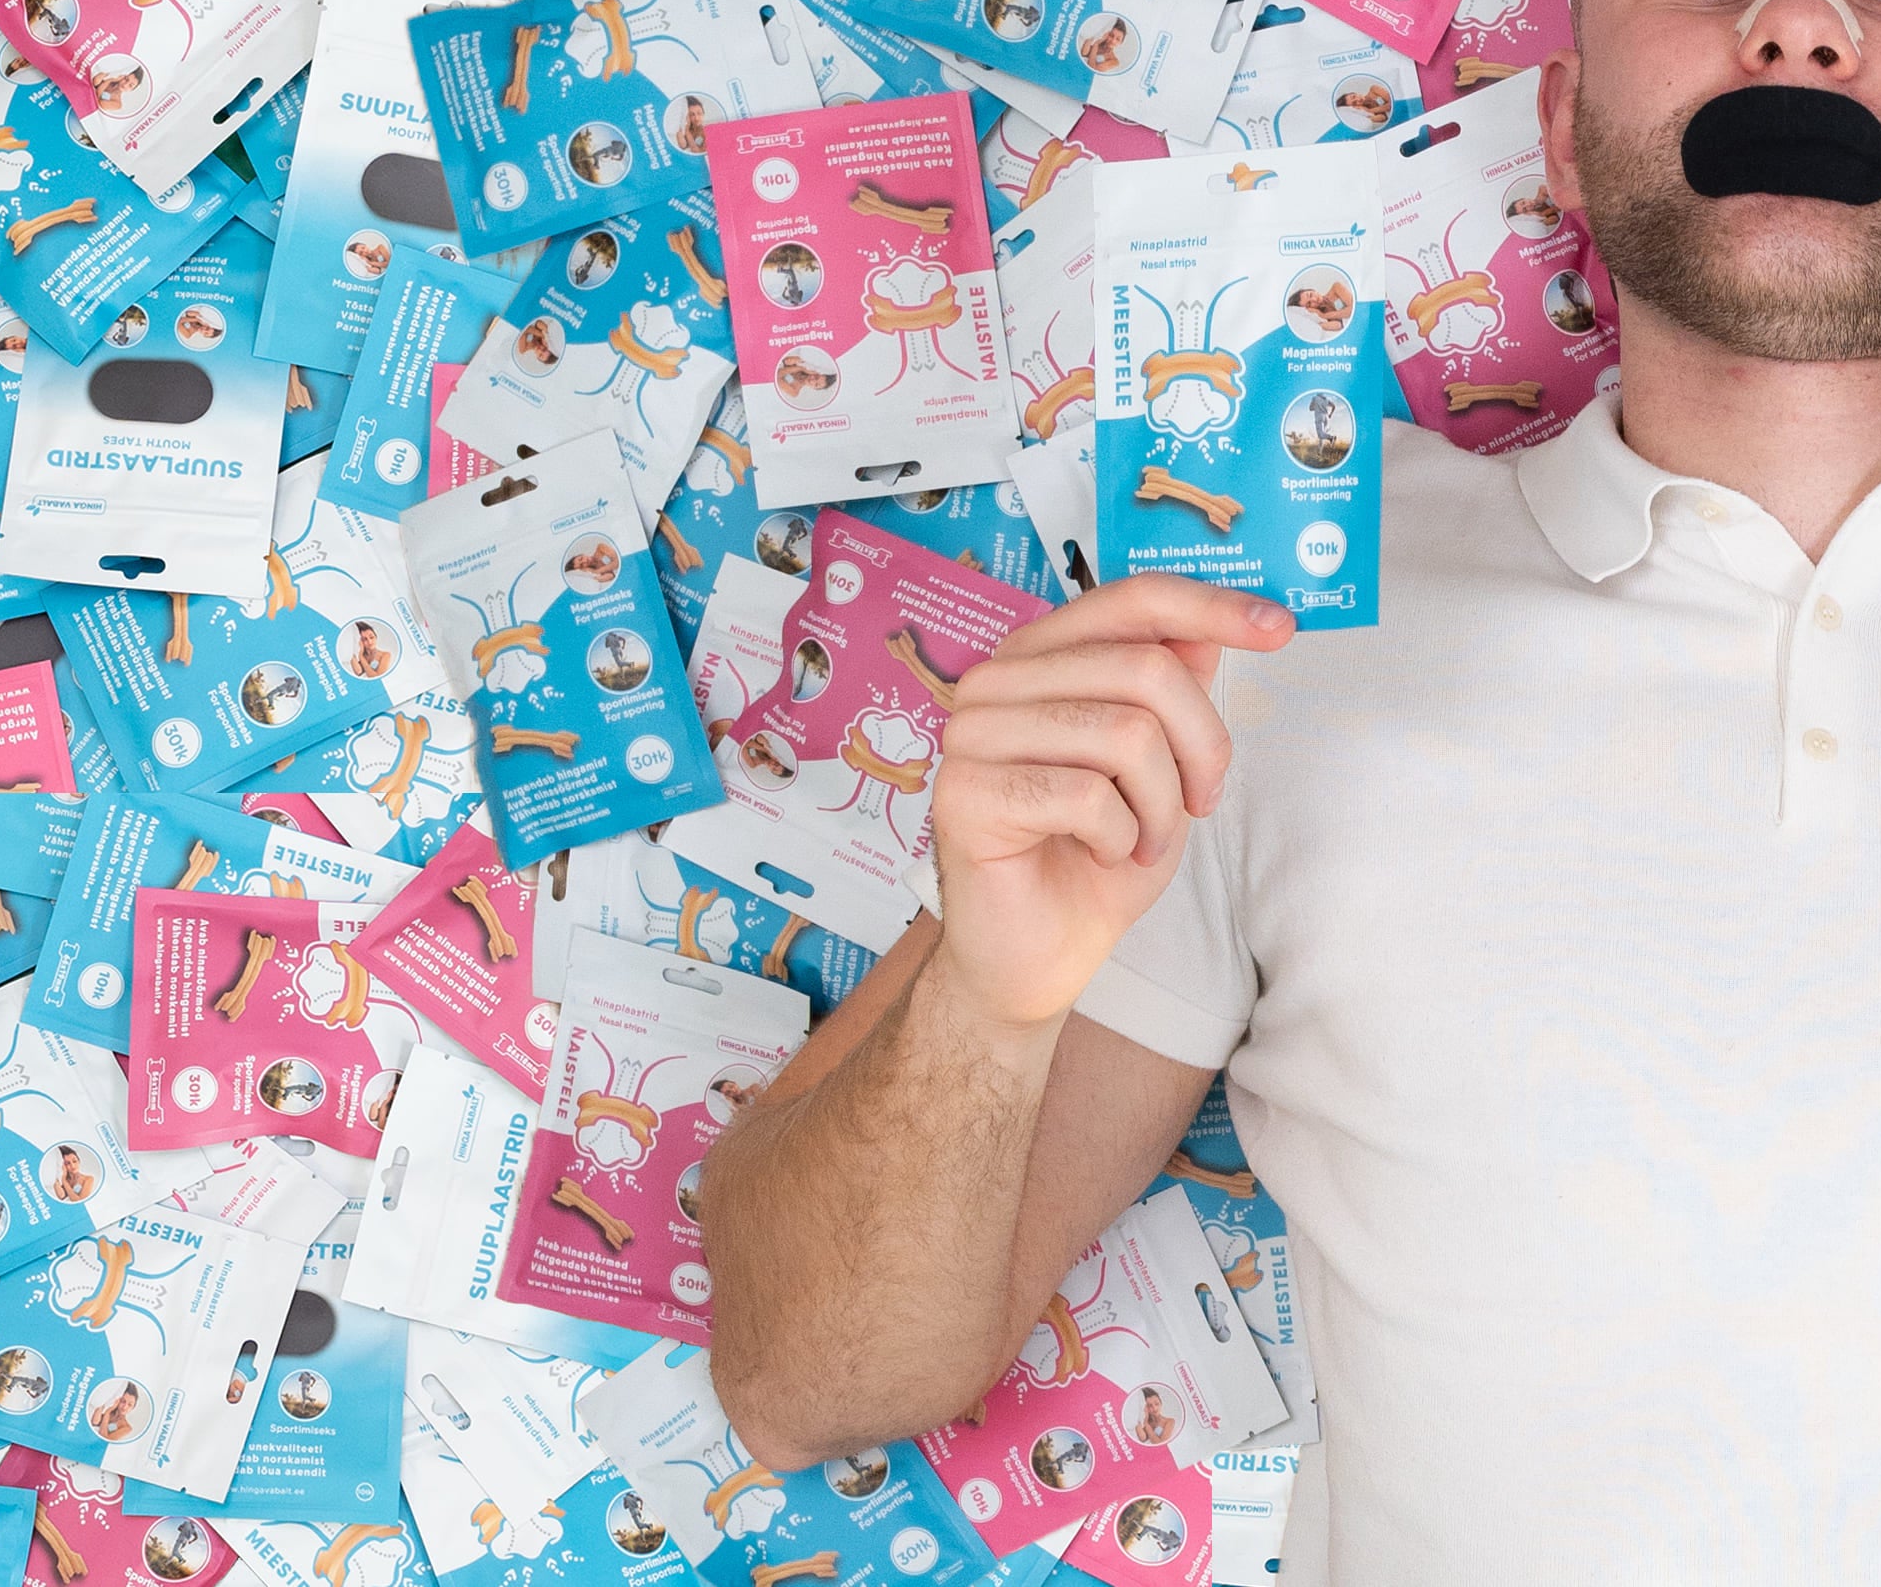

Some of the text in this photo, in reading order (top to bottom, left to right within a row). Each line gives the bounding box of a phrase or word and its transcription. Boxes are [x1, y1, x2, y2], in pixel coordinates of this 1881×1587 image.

[848, 115, 948, 134] www.hingavabalt.ee
[844, 158, 953, 179] Avab ninasõõrmed
[760, 173, 792, 187] 10tk
[1129, 235, 1208, 252] Ninaplaastrid
[1283, 236, 1355, 251] HINGA VABALT
[1140, 257, 1197, 270] Nasal strips
[971, 286, 999, 380] NAISTELE
[1112, 285, 1132, 407] MEESTELE
[1282, 343, 1358, 361] Magamiseks
[1287, 360, 1352, 373] For sleeping
[102, 435, 192, 450] MOUTH TAPES
[46, 449, 244, 479] SUUPLAASTRID
[1281, 474, 1359, 491] Sportimiseks
[1291, 490, 1352, 504] For sporting
[1128, 542, 1243, 559] Avab ninasõõrmed
[1306, 541, 1339, 556] 10tk
[1199, 559, 1263, 574] hingamist
[570, 589, 633, 615] Magamiseks
[598, 687, 664, 713] Sportimiseks
[631, 750, 668, 770] 30tk
[556, 1026, 587, 1120] NAISTELE
